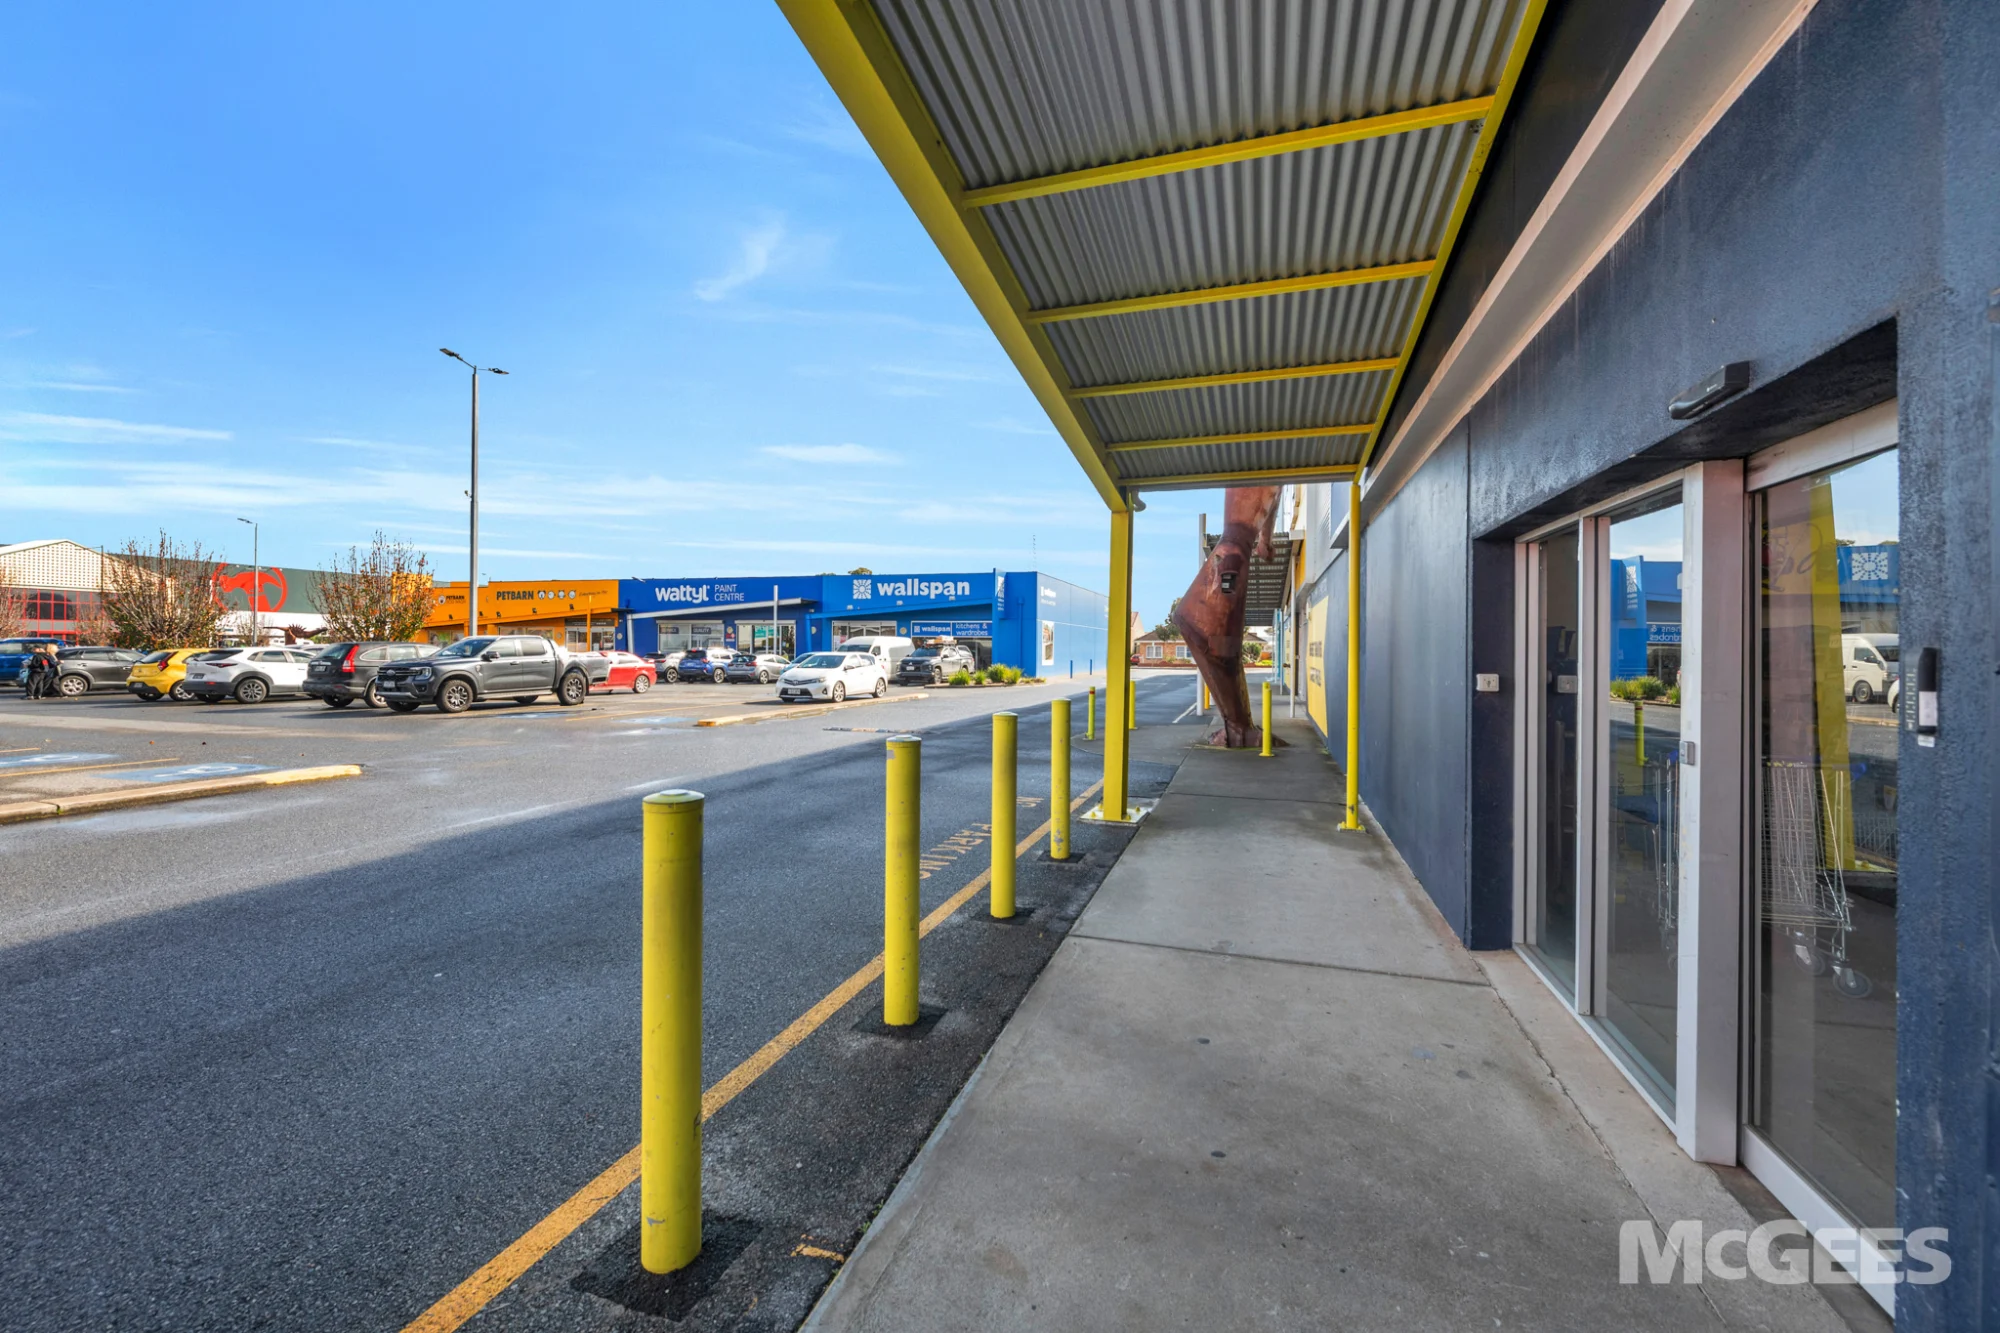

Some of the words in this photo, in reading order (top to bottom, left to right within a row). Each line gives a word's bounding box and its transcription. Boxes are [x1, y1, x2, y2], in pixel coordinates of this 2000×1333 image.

[714, 584, 738, 593] PAINT
[877, 578, 970, 599] wallspan
[496, 590, 534, 601] PETBARN
[655, 584, 709, 604] wattyl
[714, 592, 745, 601] CENTRE
[921, 625, 951, 633] wallspan
[955, 622, 980, 630] kitchens
